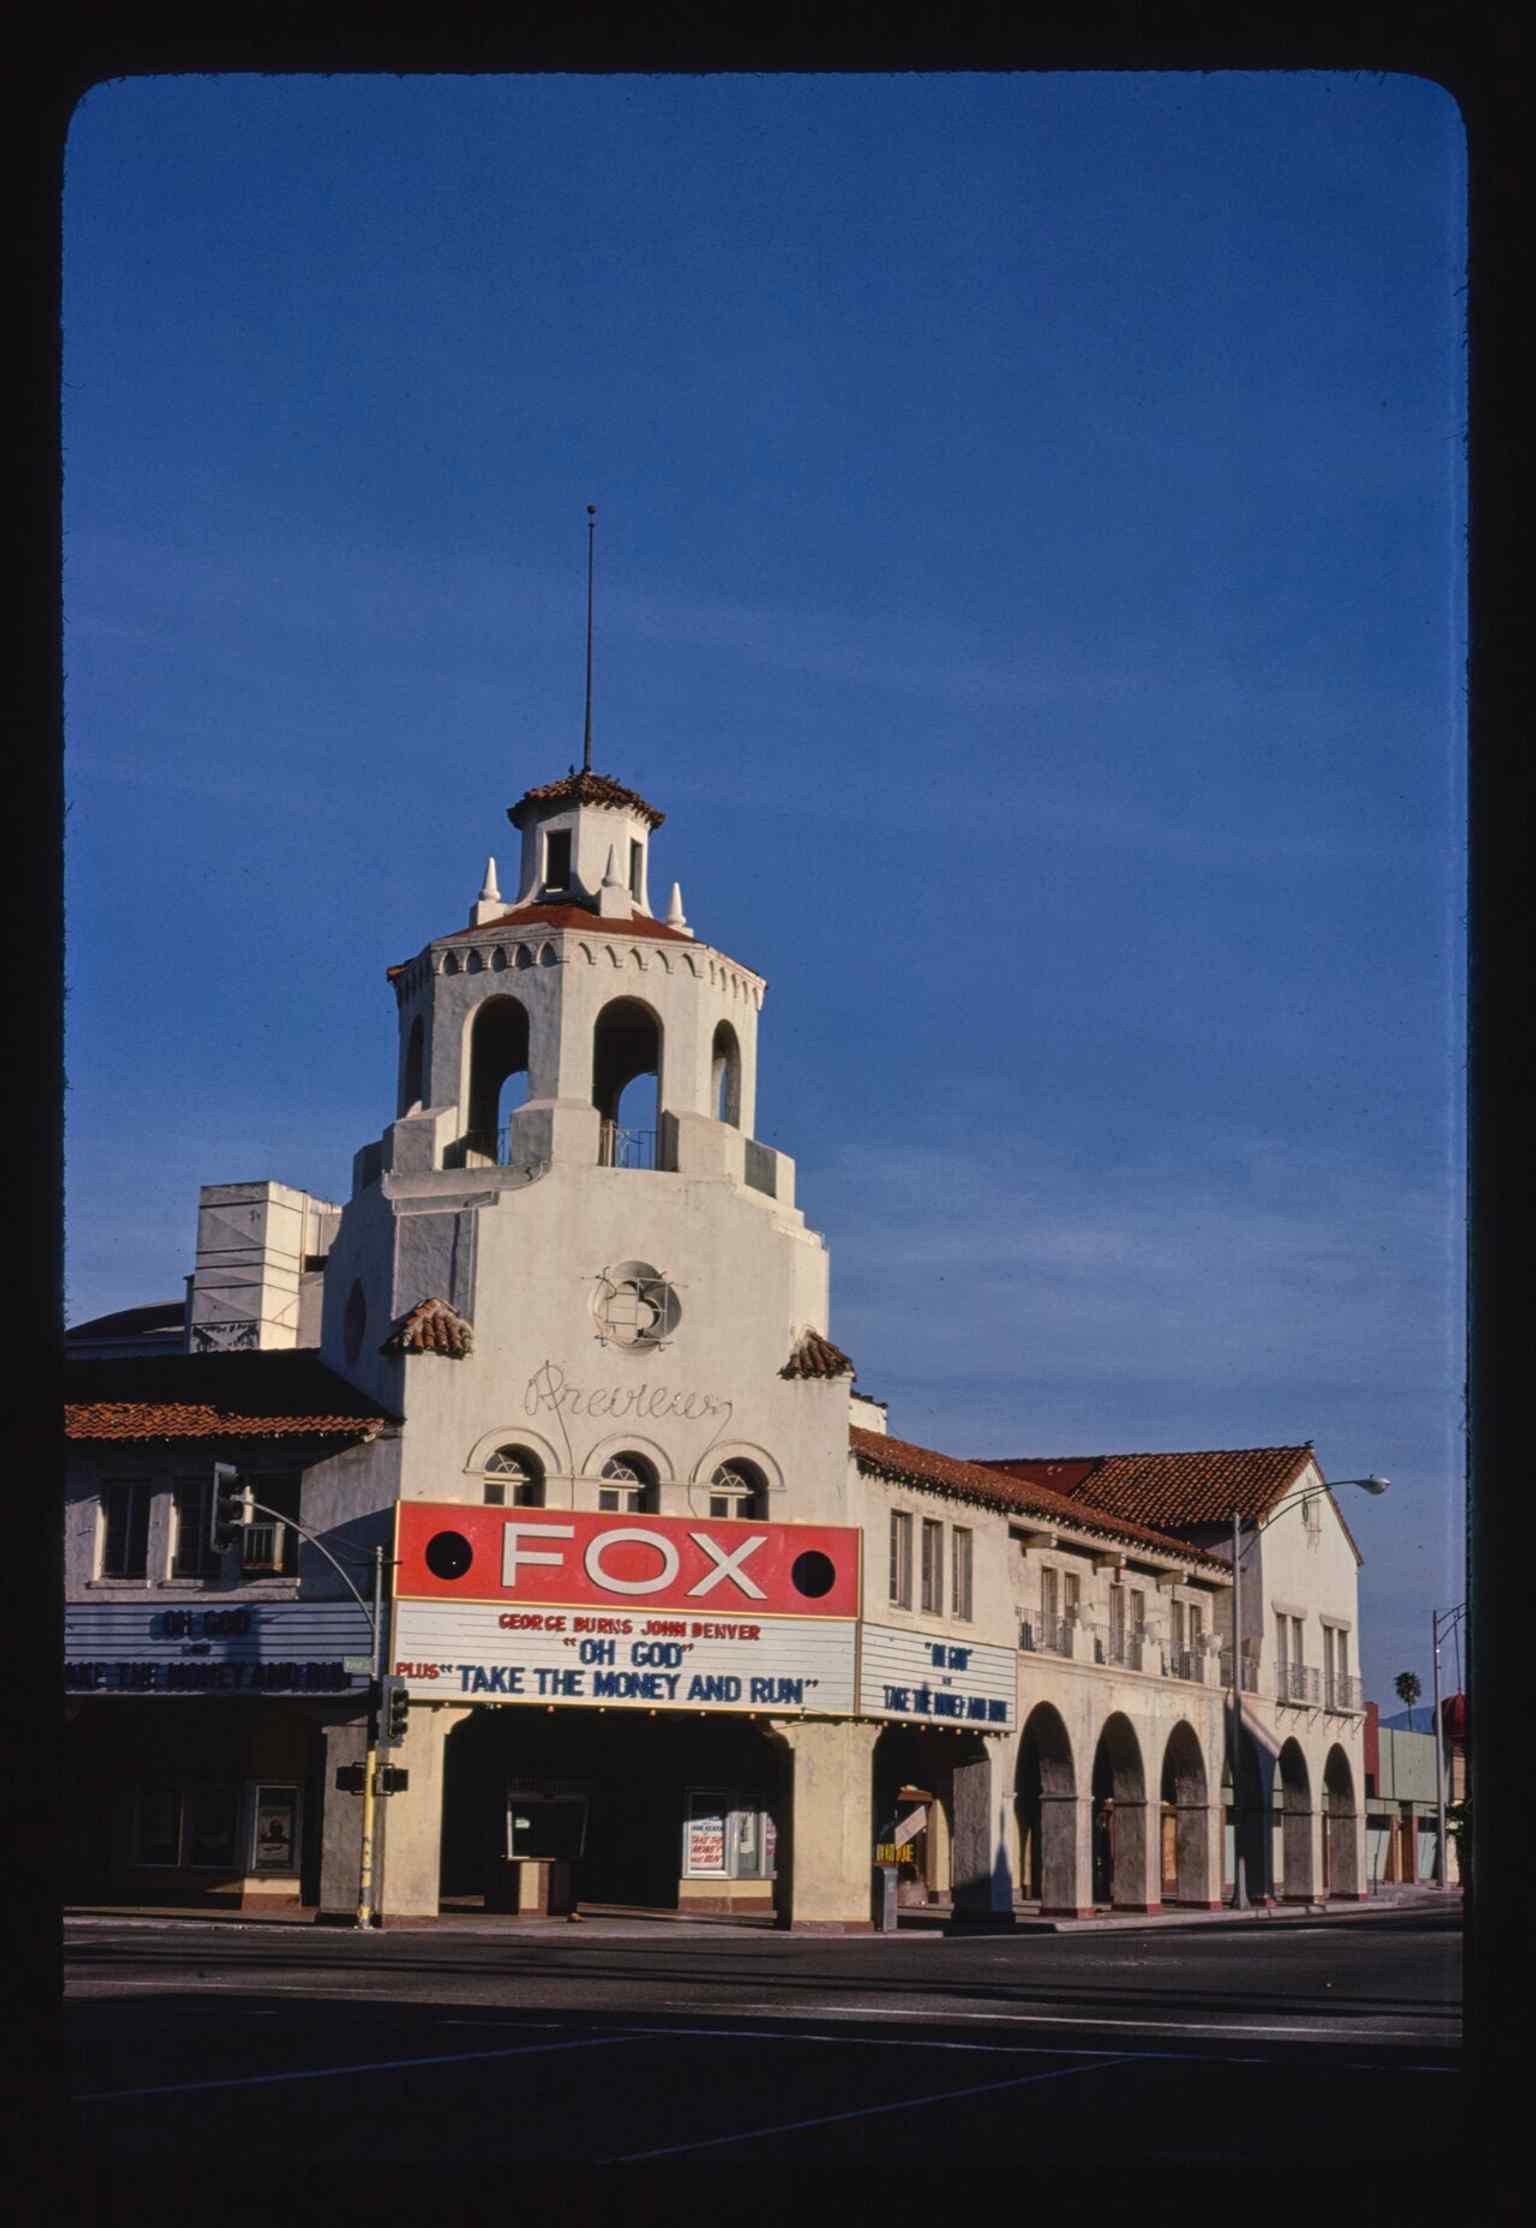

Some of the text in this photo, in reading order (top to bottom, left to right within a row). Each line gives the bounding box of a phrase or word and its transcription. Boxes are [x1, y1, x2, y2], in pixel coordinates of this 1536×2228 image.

[502, 1521, 769, 1600] FOX
[498, 1613, 761, 1641] GEORGE BURNS JOHN DENVER
[395, 1662, 439, 1680] PLUS
[533, 1668, 585, 1696] THE
[592, 1669, 681, 1700] MONEY
[687, 1674, 742, 1702] AND
